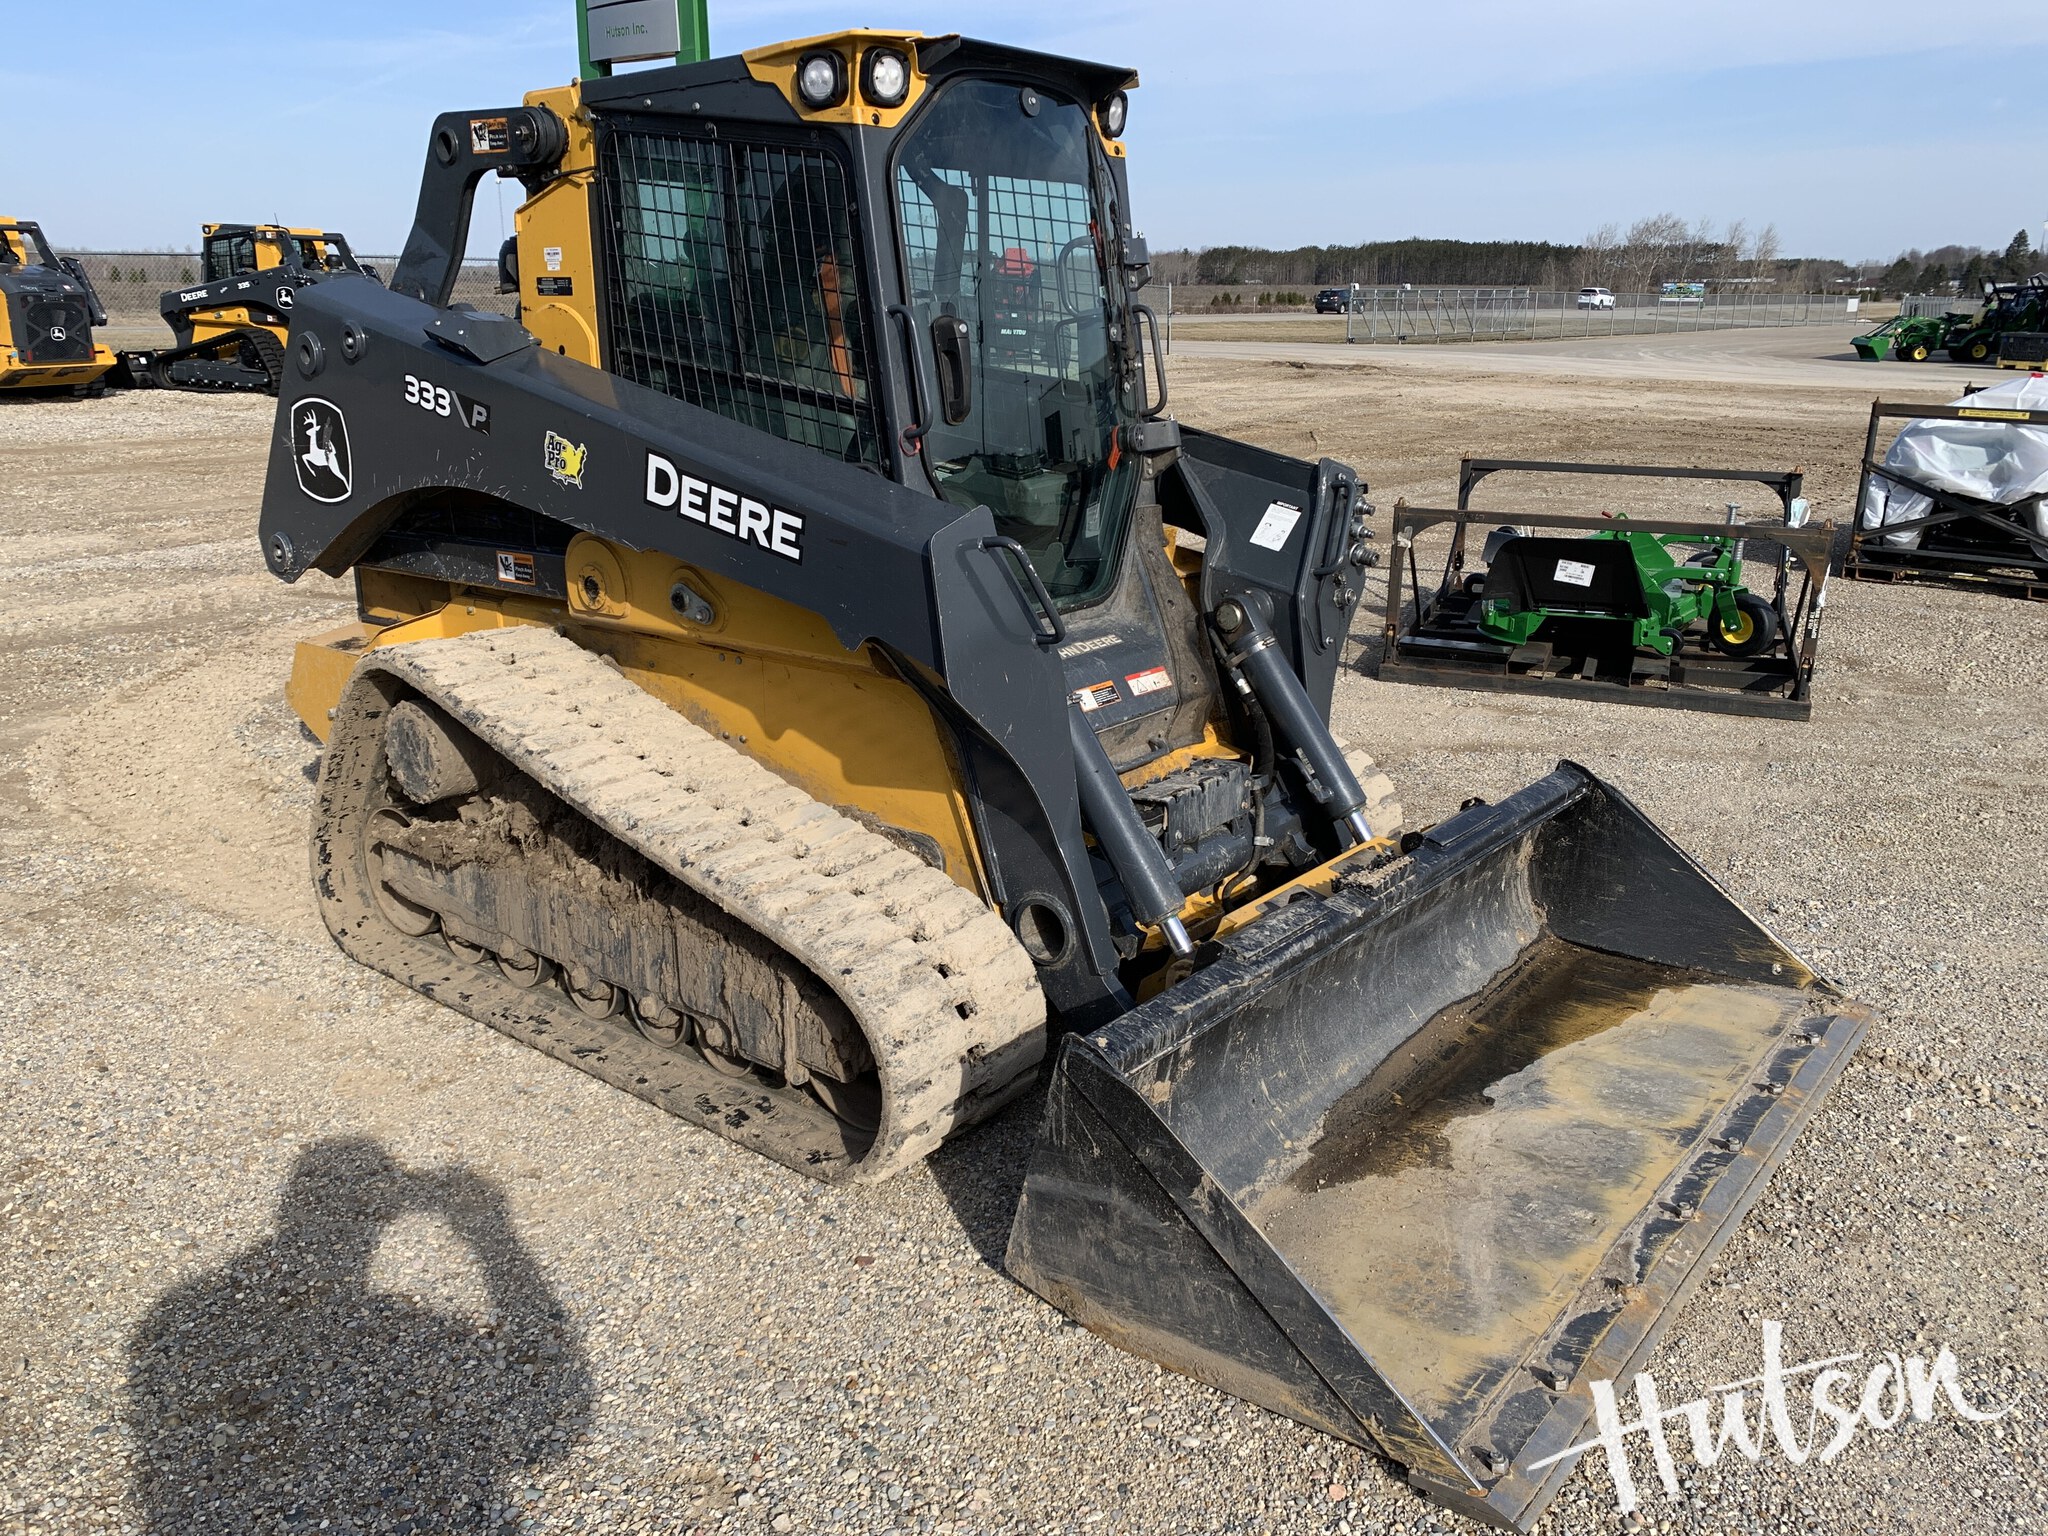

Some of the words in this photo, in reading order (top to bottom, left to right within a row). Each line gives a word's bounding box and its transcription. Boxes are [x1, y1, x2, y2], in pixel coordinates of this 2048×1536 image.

[605, 25, 630, 39] Hutson
[632, 22, 648, 35] Inc.
[180, 289, 209, 303] DEERE
[404, 374, 451, 417] 333
[471, 403, 488, 428] P
[547, 433, 567, 457] Ag-
[547, 450, 568, 470] Pro
[646, 452, 804, 561] DEERE
[1059, 646, 1081, 657] HN
[1075, 634, 1122, 651] DEERE
